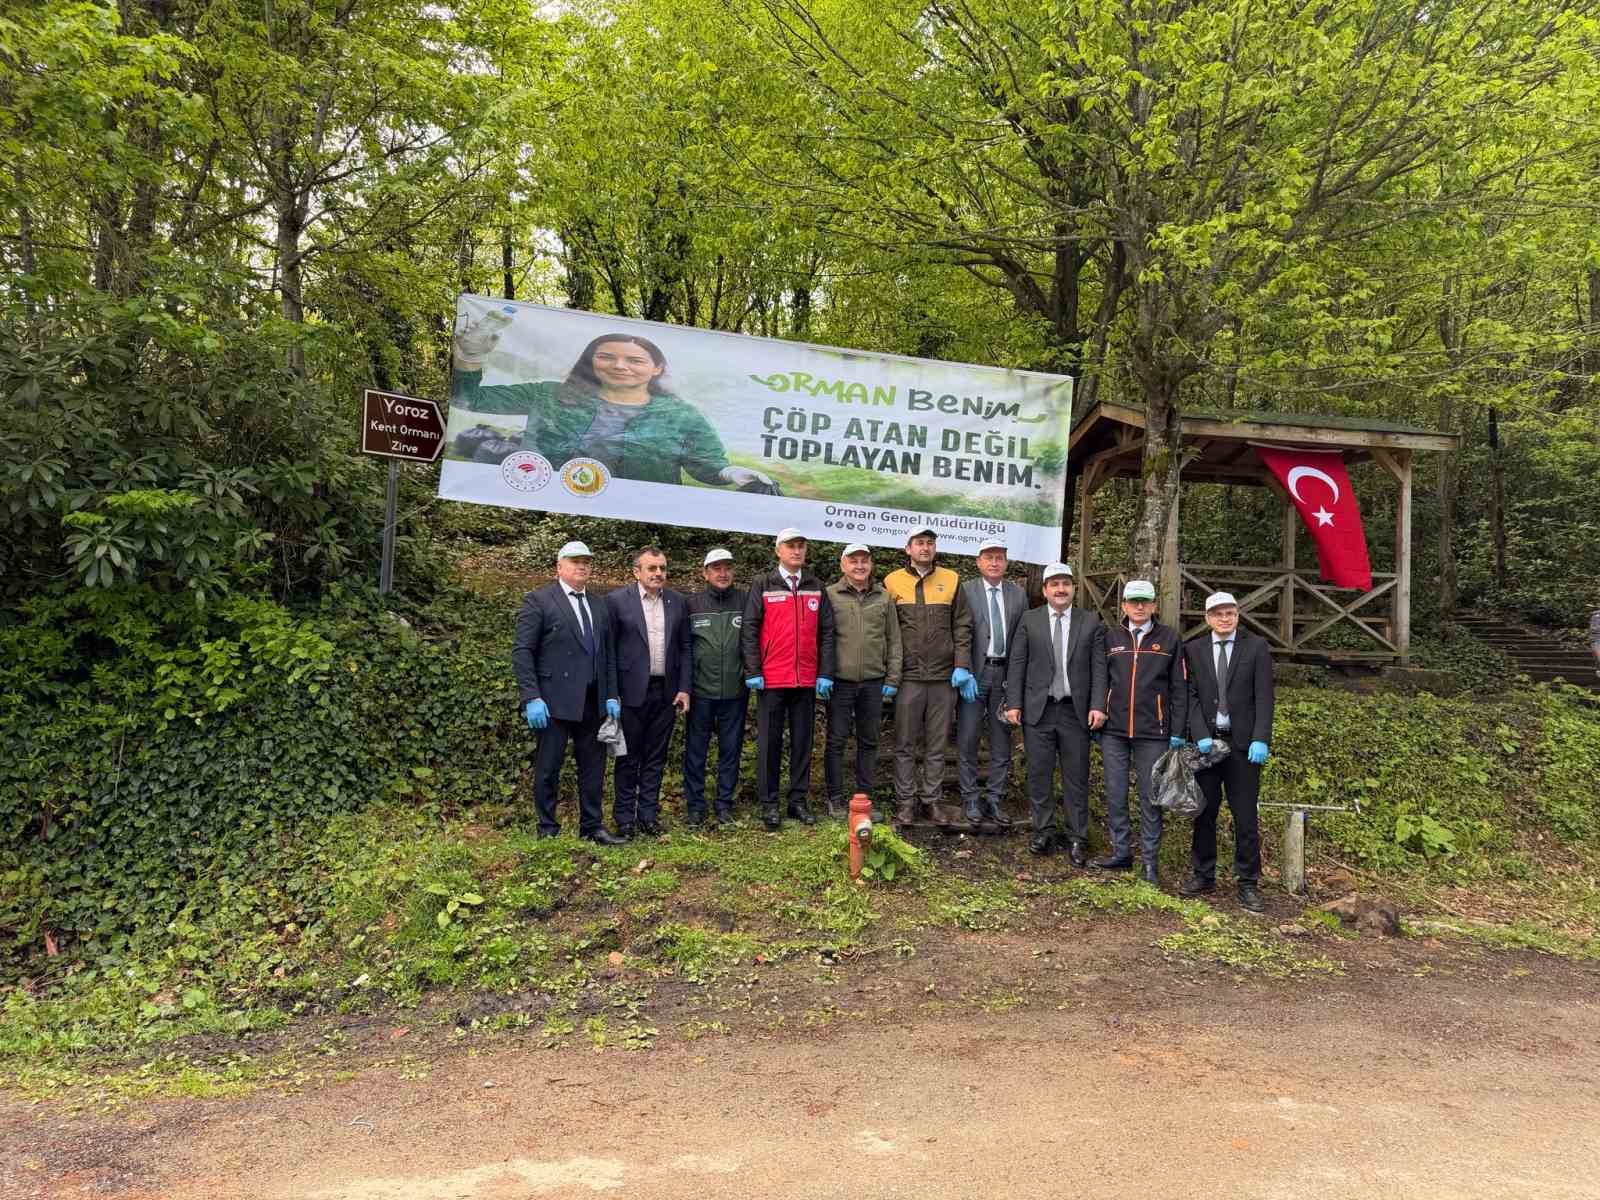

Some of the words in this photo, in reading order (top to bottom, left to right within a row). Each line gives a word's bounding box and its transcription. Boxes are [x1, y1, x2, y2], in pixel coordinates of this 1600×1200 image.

[749, 371, 896, 406] ORMAN
[383, 398, 430, 420] Yoroz
[370, 419, 397, 433] Kent
[400, 424, 440, 440] Ormanı
[763, 406, 832, 434] ÇÖP
[843, 417, 928, 449] ATAN
[759, 433, 922, 476] TOPLAYAN
[825, 504, 876, 521] Orman
[880, 511, 922, 526] Genel
[926, 516, 1006, 535] Müdürlüğü
